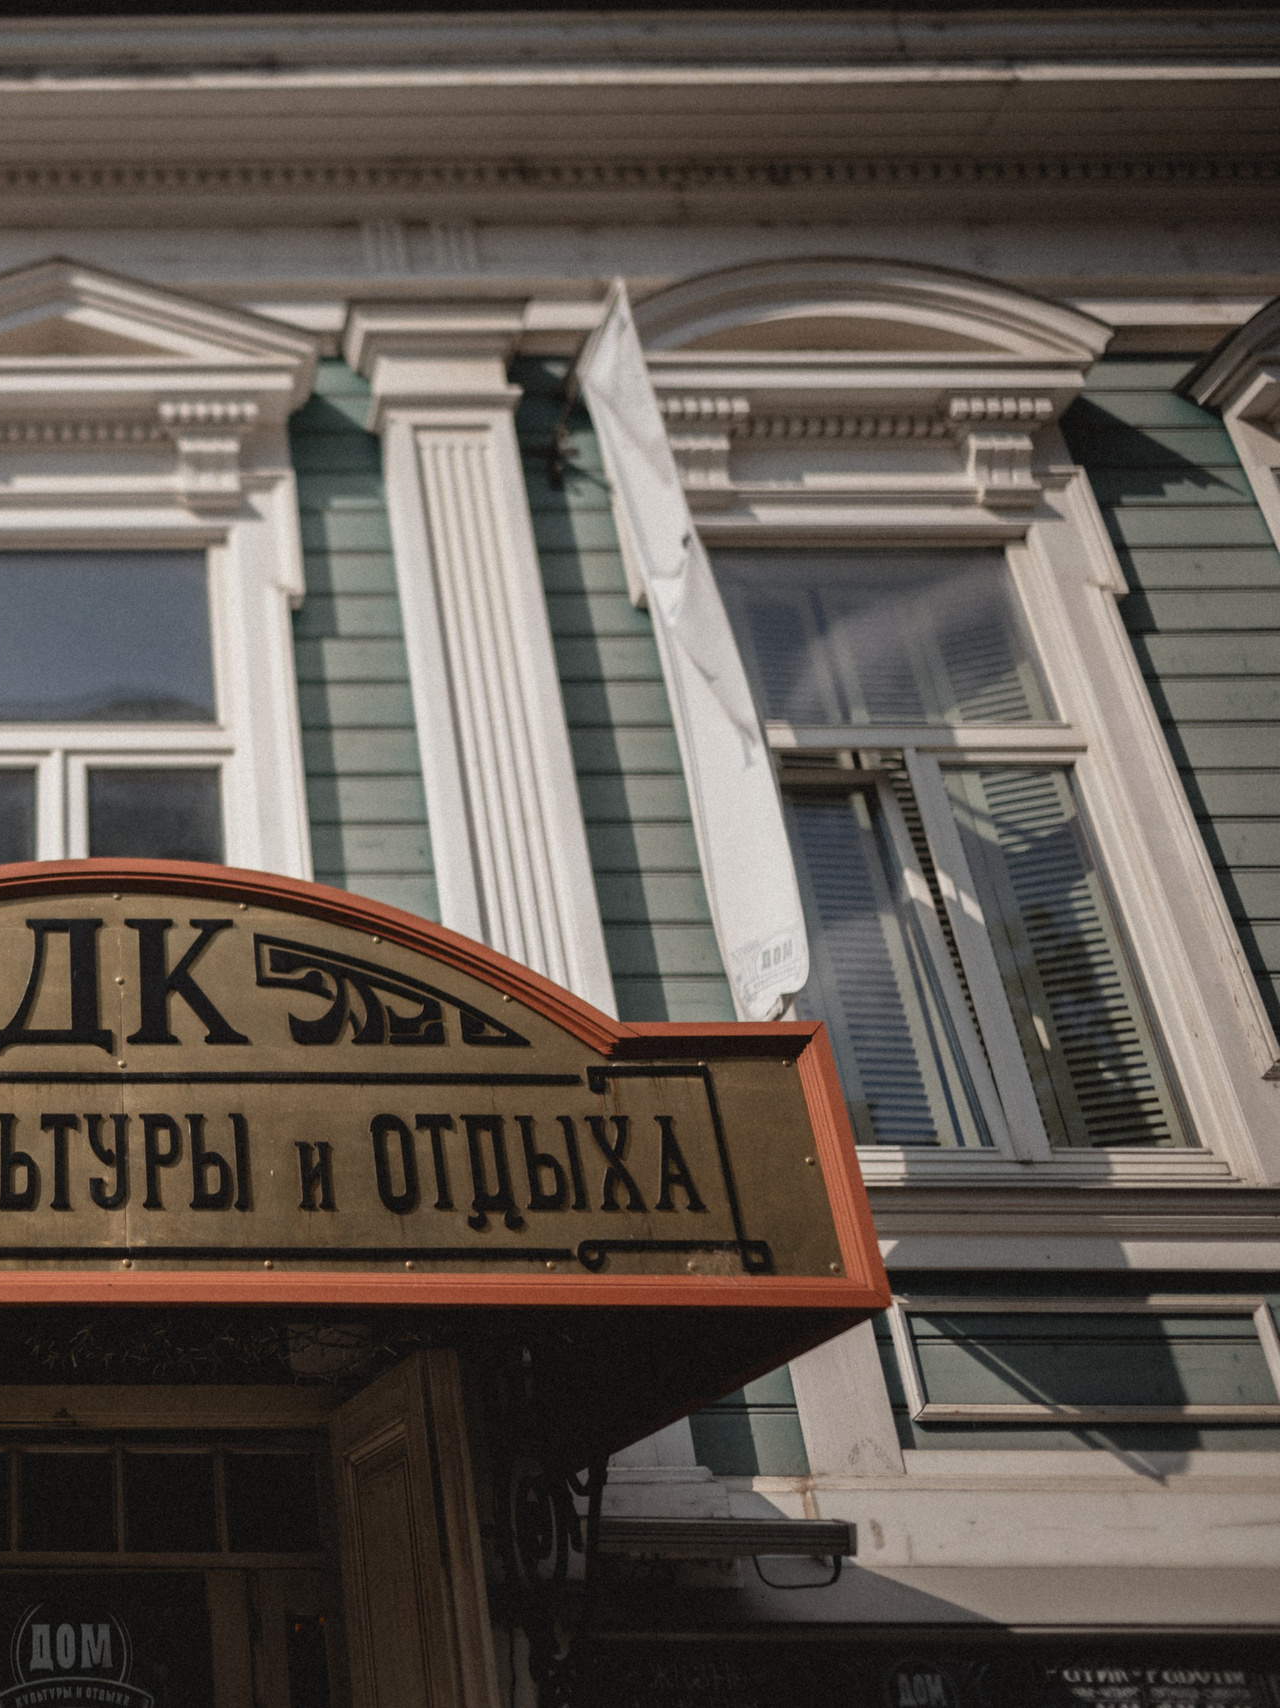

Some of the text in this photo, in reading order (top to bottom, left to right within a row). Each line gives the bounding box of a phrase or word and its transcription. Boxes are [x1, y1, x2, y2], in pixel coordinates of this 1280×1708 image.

[370, 1112, 709, 1231] ОТДЫХА
[30, 1623, 113, 1672] ДОМ
[15, 1686, 72, 1708] КУЛЬТУРЫ
